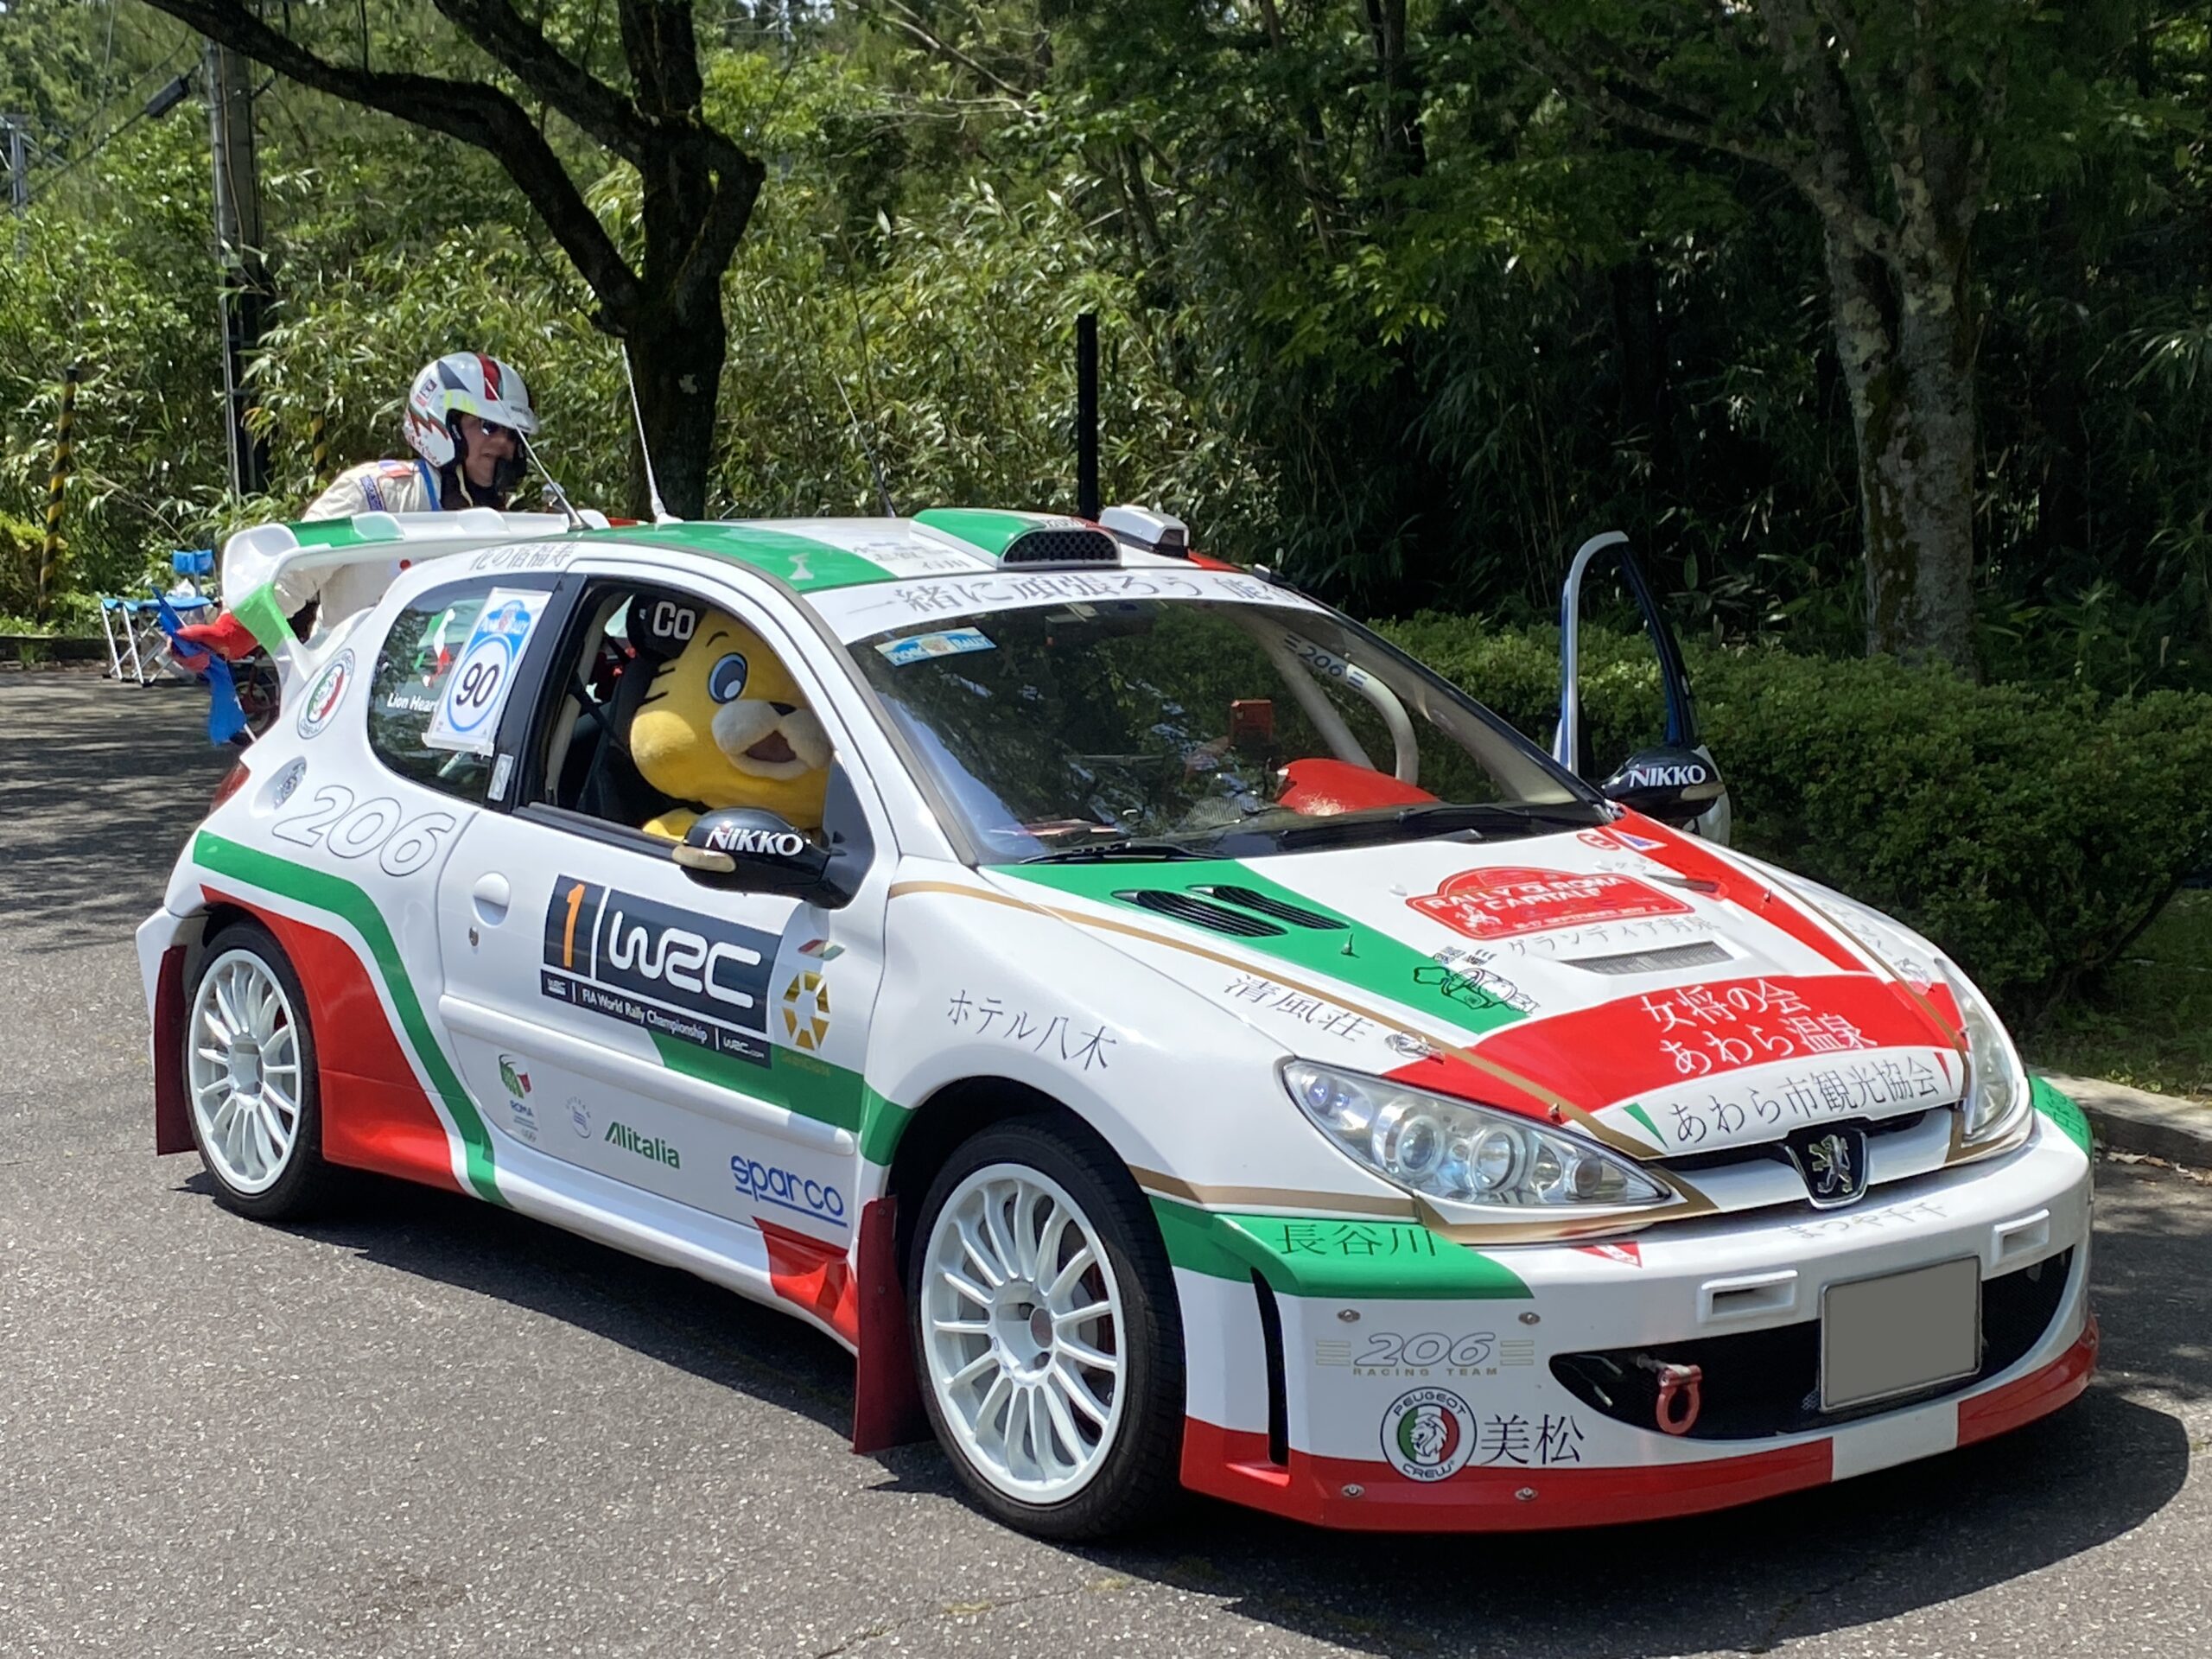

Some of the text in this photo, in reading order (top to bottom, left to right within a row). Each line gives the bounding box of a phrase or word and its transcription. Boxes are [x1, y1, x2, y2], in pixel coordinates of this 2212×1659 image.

[652, 601, 696, 640] CO
[1298, 645, 1347, 677] 206
[387, 692, 408, 708] Lion
[455, 662, 499, 708] 90
[1629, 765, 1707, 788] NIKKO
[271, 785, 456, 877] 206
[704, 825, 804, 856] NIKKO
[1424, 887, 1512, 909] RALLY
[1548, 877, 1630, 891] ROMA
[563, 883, 586, 969] 1
[608, 910, 762, 1009] WRC
[582, 988, 708, 1045] FIA World Rally Championship
[1224, 974, 1376, 1042] 清風荘
[1641, 977, 1811, 1033] 女将の会
[947, 988, 1118, 1071] ホテル八木
[1659, 1013, 1878, 1075] あわら温泉
[1669, 1056, 1939, 1143] あわら市観光協会
[605, 1122, 681, 1169] Alitalia
[731, 1154, 844, 1217] sparco
[1275, 1224, 1436, 1256] 長谷川
[1353, 1332, 1497, 1366] 206
[1353, 1367, 1498, 1376] RACING TEAM
[1393, 1391, 1467, 1417] PEUGEOT
[1480, 1414, 1585, 1466] 美松
